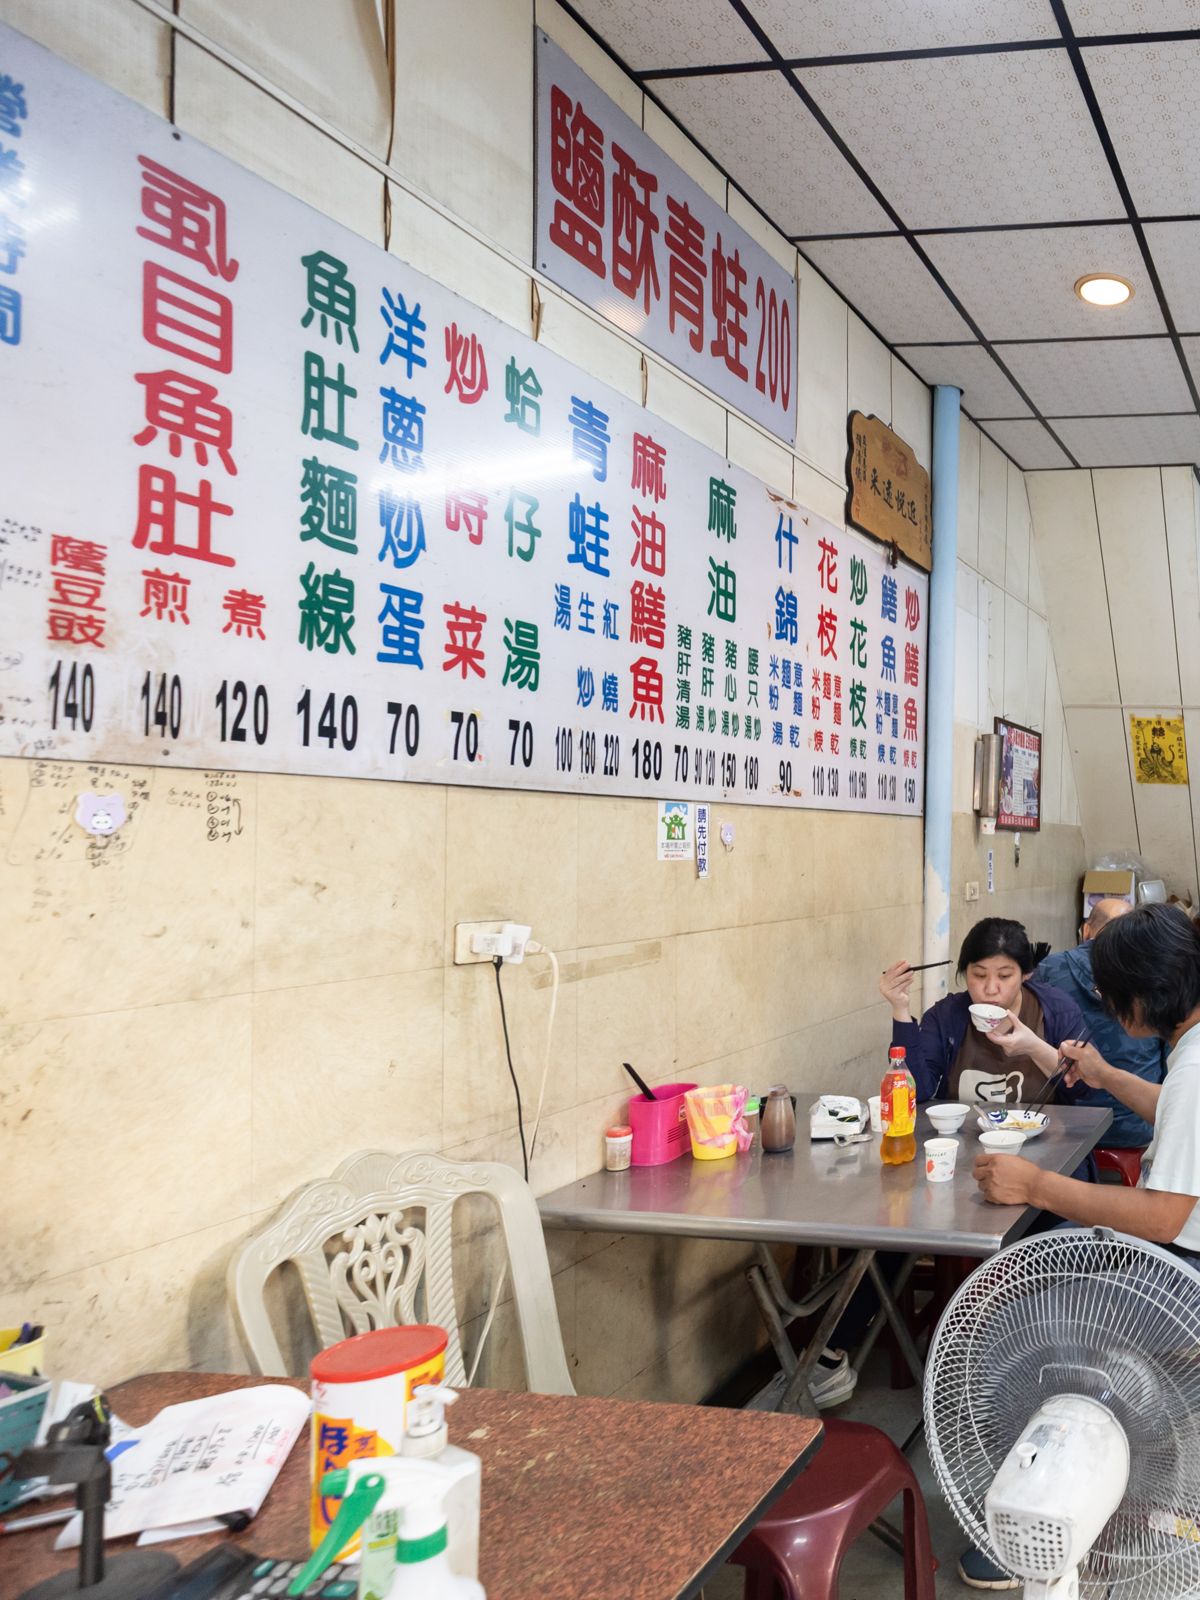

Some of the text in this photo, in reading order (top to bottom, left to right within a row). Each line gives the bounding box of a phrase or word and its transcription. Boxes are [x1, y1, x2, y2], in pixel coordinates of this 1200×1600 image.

[550, 83, 790, 412] 鹽酥青蛙200
[132, 158, 238, 572] 虱目魚肚
[299, 251, 358, 654] 魚肚麵線
[443, 324, 488, 678] 炒時菜
[567, 396, 611, 577] 青蛙
[503, 358, 540, 691] 蛤仔湯
[708, 478, 736, 622] 麻油
[140, 569, 190, 624] 煎
[630, 434, 666, 723] 麻油鱔魚
[774, 512, 799, 647] 什錦
[817, 537, 839, 662] 花枝
[223, 589, 266, 640] 煮
[553, 583, 573, 633] 湯
[880, 574, 899, 684] 鱔魚
[701, 632, 716, 699] 豬肝
[724, 639, 738, 703] 豬心
[849, 554, 869, 731] 炒花枝
[903, 586, 921, 742] 炒鱔魚
[50, 661, 93, 732] 140
[142, 672, 181, 739] 140
[675, 624, 693, 731] 豬肝清湯
[746, 647, 760, 709] 腰只
[216, 680, 268, 745] 120
[298, 690, 357, 750] 140
[388, 702, 419, 756] 70
[451, 711, 478, 762] 70
[772, 721, 784, 746] 湯
[789, 724, 801, 749] 乾
[509, 720, 533, 767] 70
[555, 726, 573, 773] 100
[579, 730, 596, 775] 180
[603, 733, 620, 777] 220
[633, 740, 662, 780] 180
[674, 744, 689, 783] 70
[694, 747, 702, 785] 90
[705, 749, 716, 786] 120
[721, 751, 737, 788] 150
[829, 732, 841, 755] 乾
[744, 755, 759, 790] 180
[779, 760, 793, 793] 90
[812, 764, 825, 796] 110
[827, 766, 840, 798] 130
[904, 778, 916, 803] 150
[698, 808, 707, 872] 請先付款
